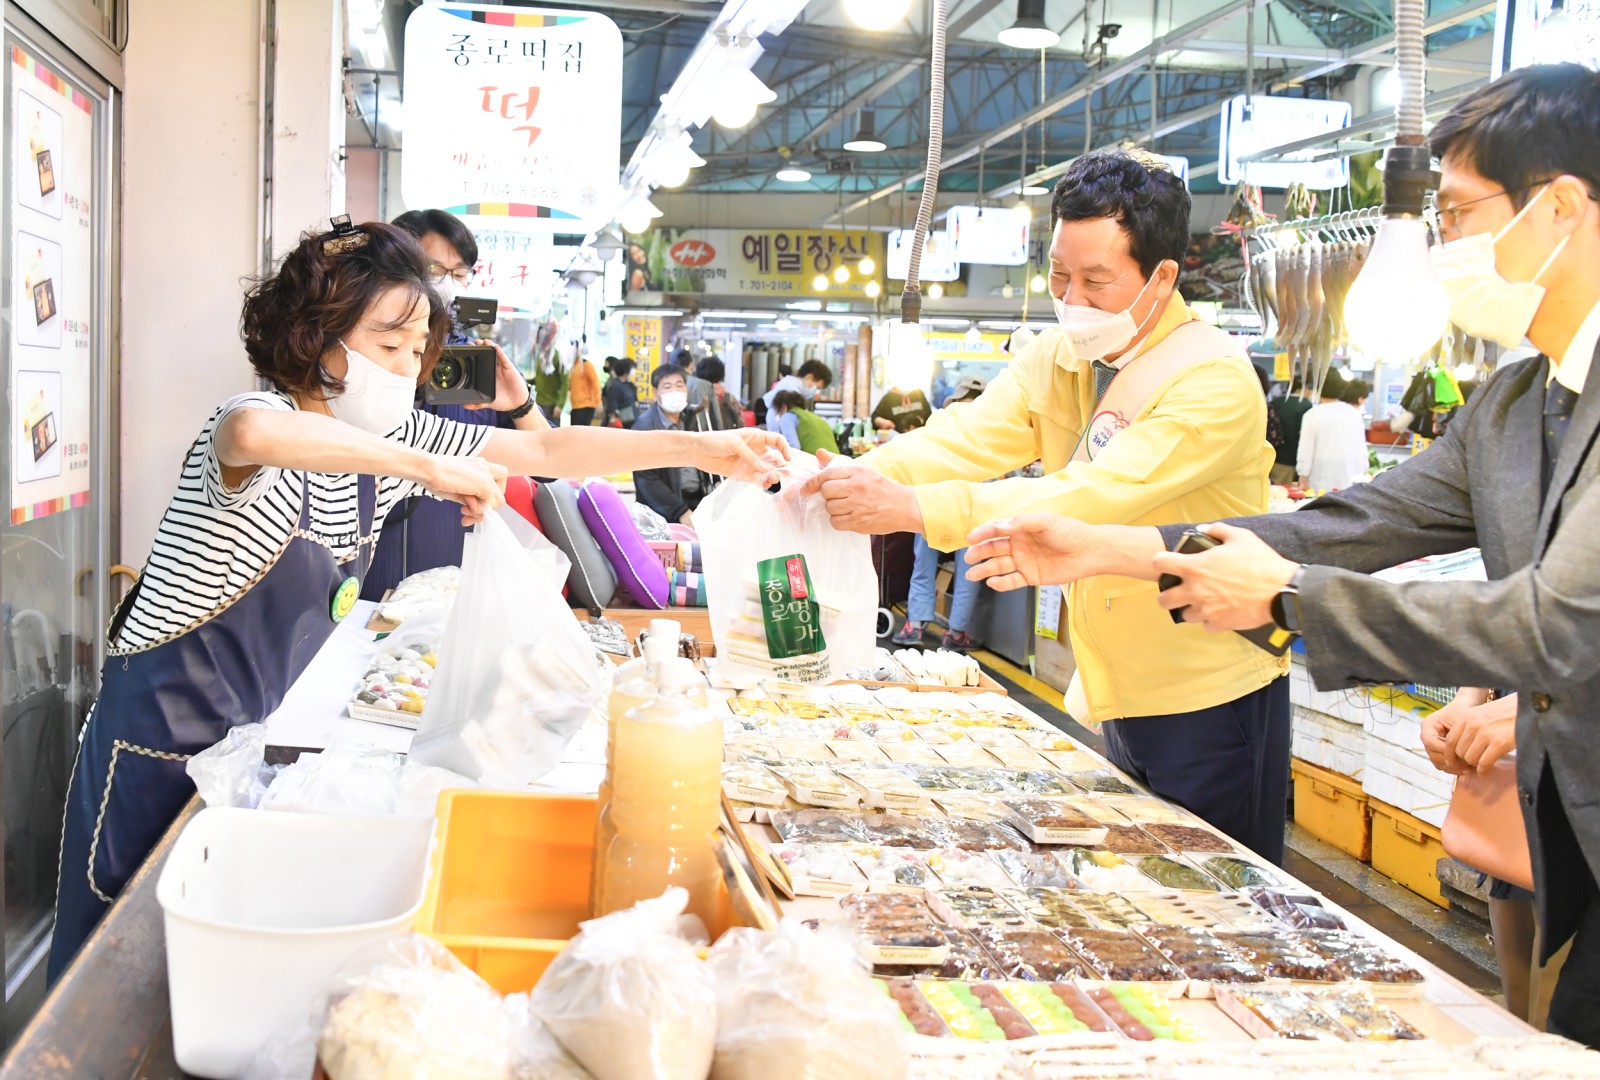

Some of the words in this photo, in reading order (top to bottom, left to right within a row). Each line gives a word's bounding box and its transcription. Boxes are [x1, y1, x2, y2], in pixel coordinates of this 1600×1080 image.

[446, 33, 583, 73] 종로떡집
[477, 85, 542, 148] 떡
[742, 233, 868, 274] 예일장식
[750, 280, 793, 291] 701-2104
